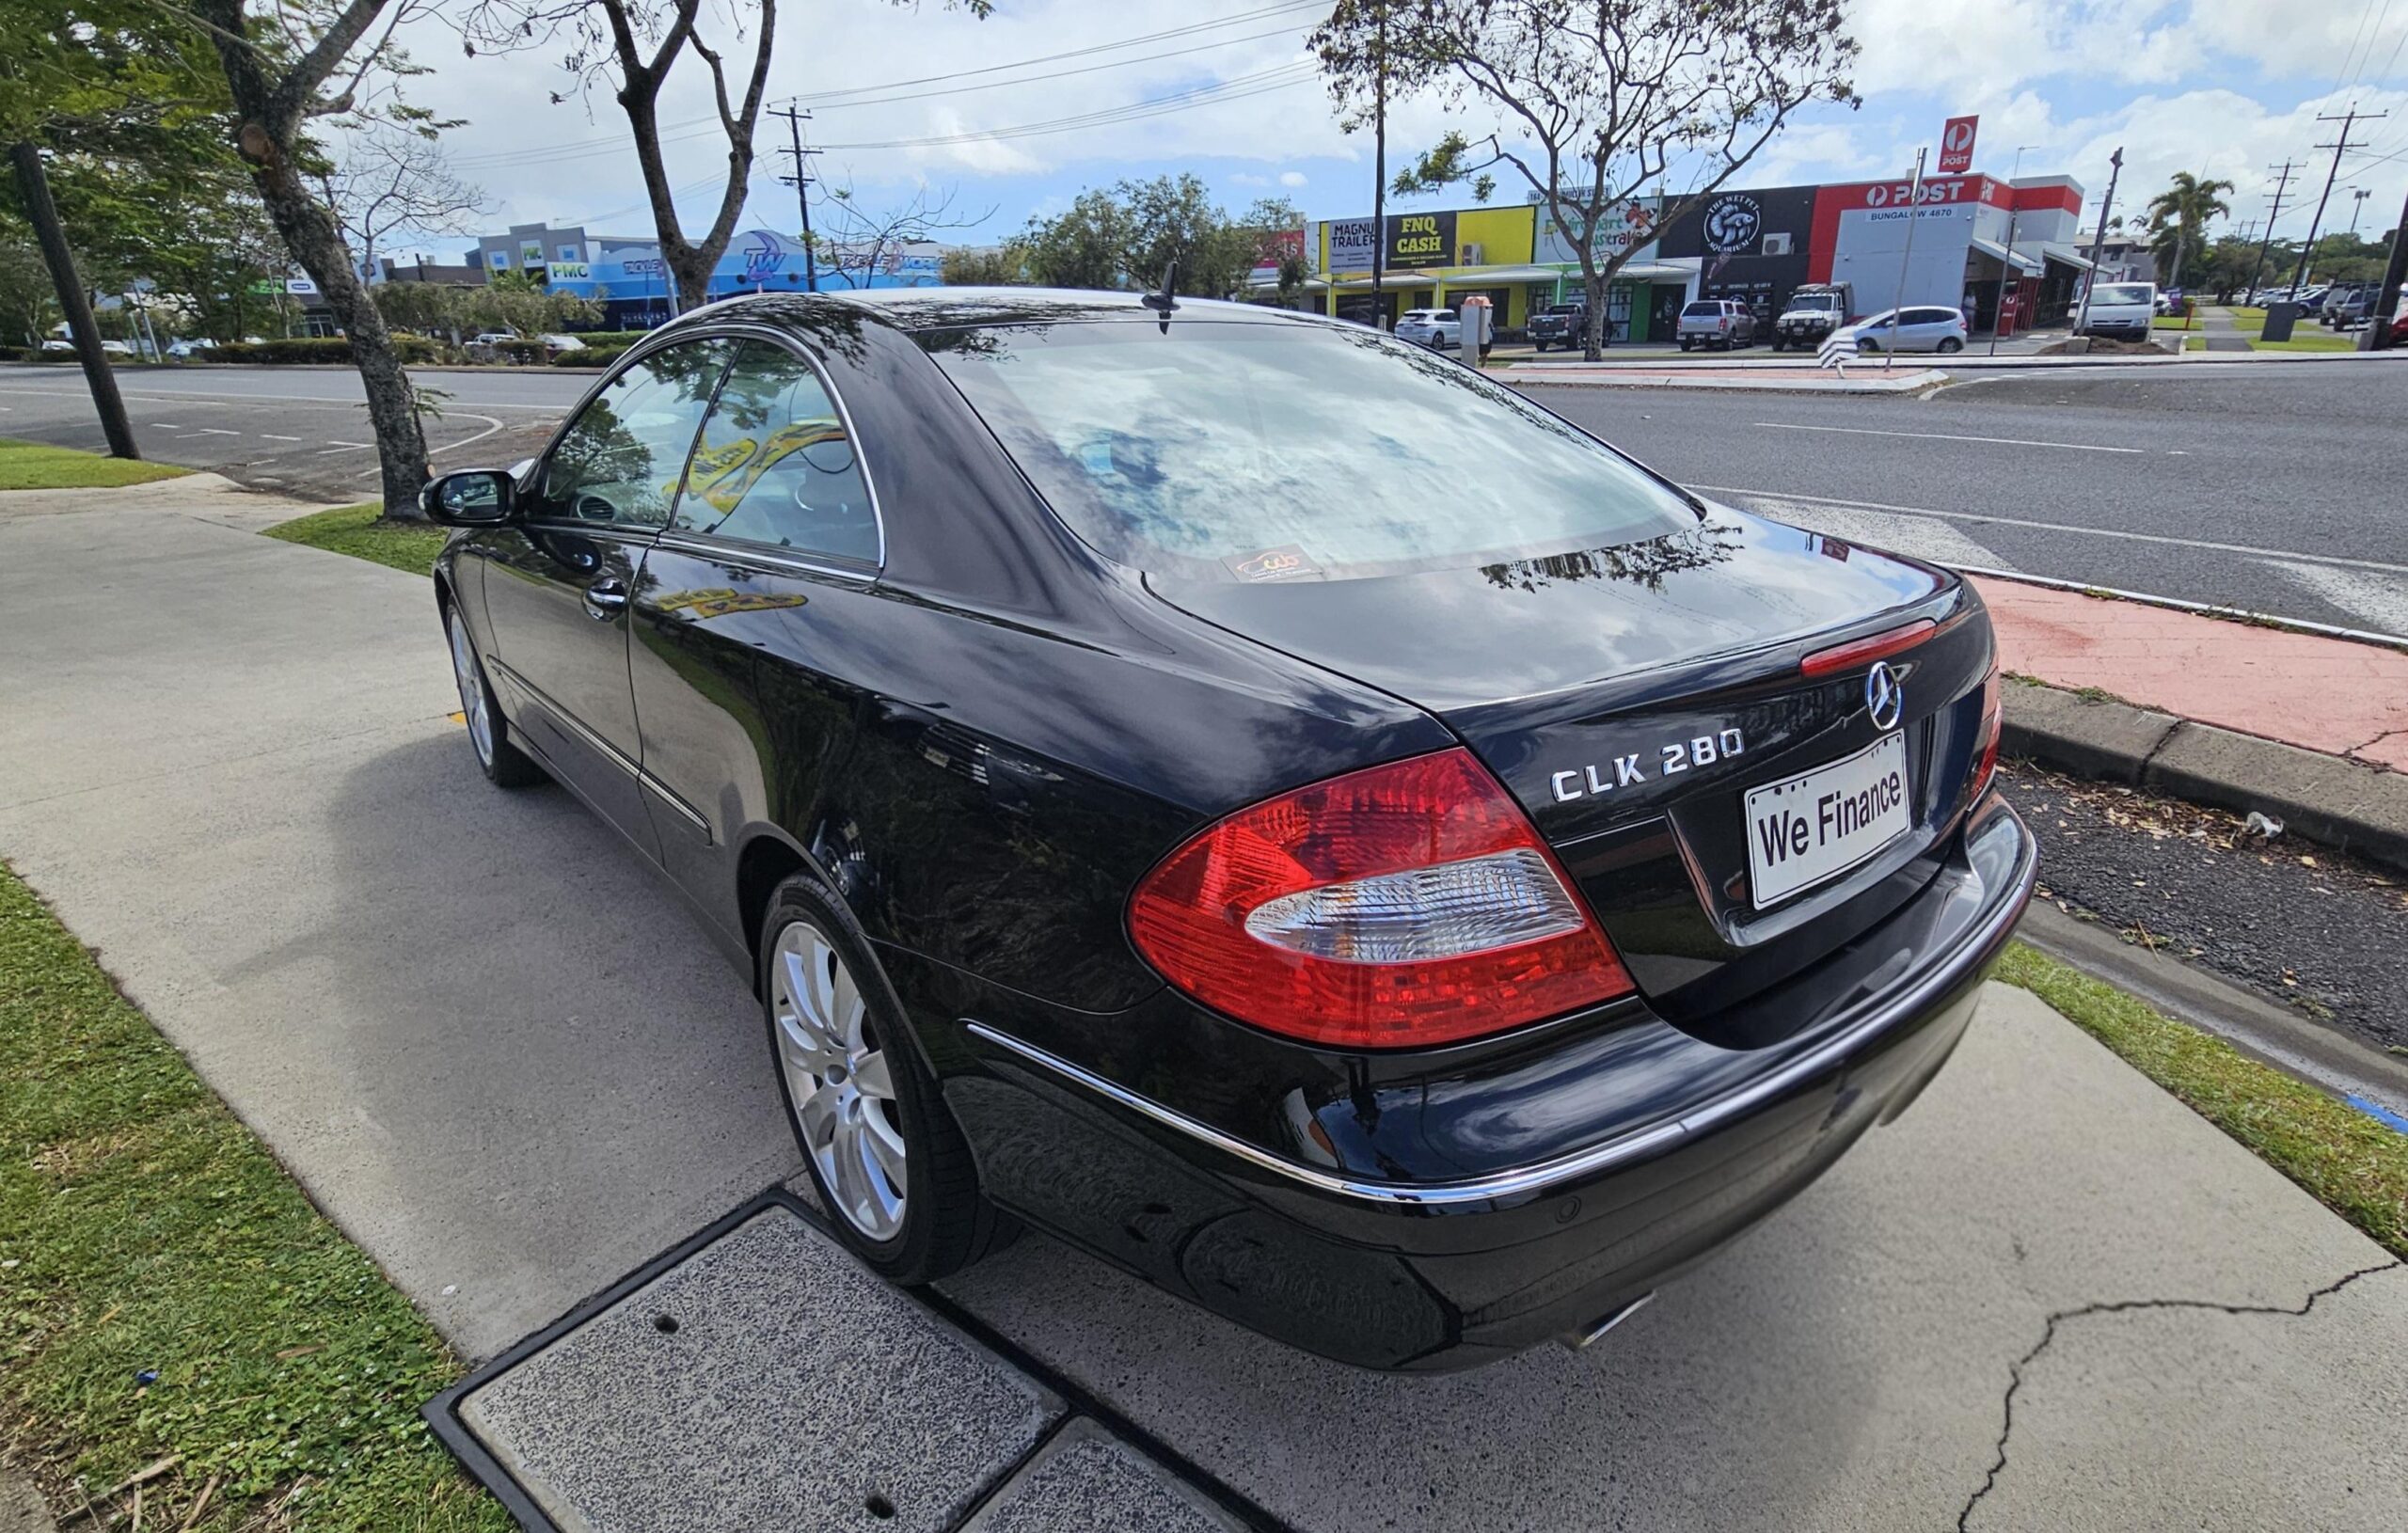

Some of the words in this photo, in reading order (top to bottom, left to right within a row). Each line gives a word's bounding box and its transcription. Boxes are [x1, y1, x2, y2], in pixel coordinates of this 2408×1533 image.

[1941, 156, 1969, 166] POST
[1893, 182, 1964, 205] POST
[1708, 198, 1724, 213] THE
[1725, 195, 1745, 203] WET
[1744, 197, 1760, 211] PET
[1870, 210, 1927, 221] BUNGALW
[1928, 209, 1953, 218] 4870
[1334, 222, 1375, 236] MAGNU
[1401, 216, 1438, 236] FNQ
[1331, 234, 1375, 248] TRAILER
[1396, 235, 1442, 254] CASH
[623, 260, 658, 275] TACKLE
[744, 247, 786, 273] TW
[1551, 753, 1646, 803] CLK
[1661, 728, 1745, 776] 280
[1758, 810, 1810, 867] We
[1817, 771, 1901, 846] Finance
